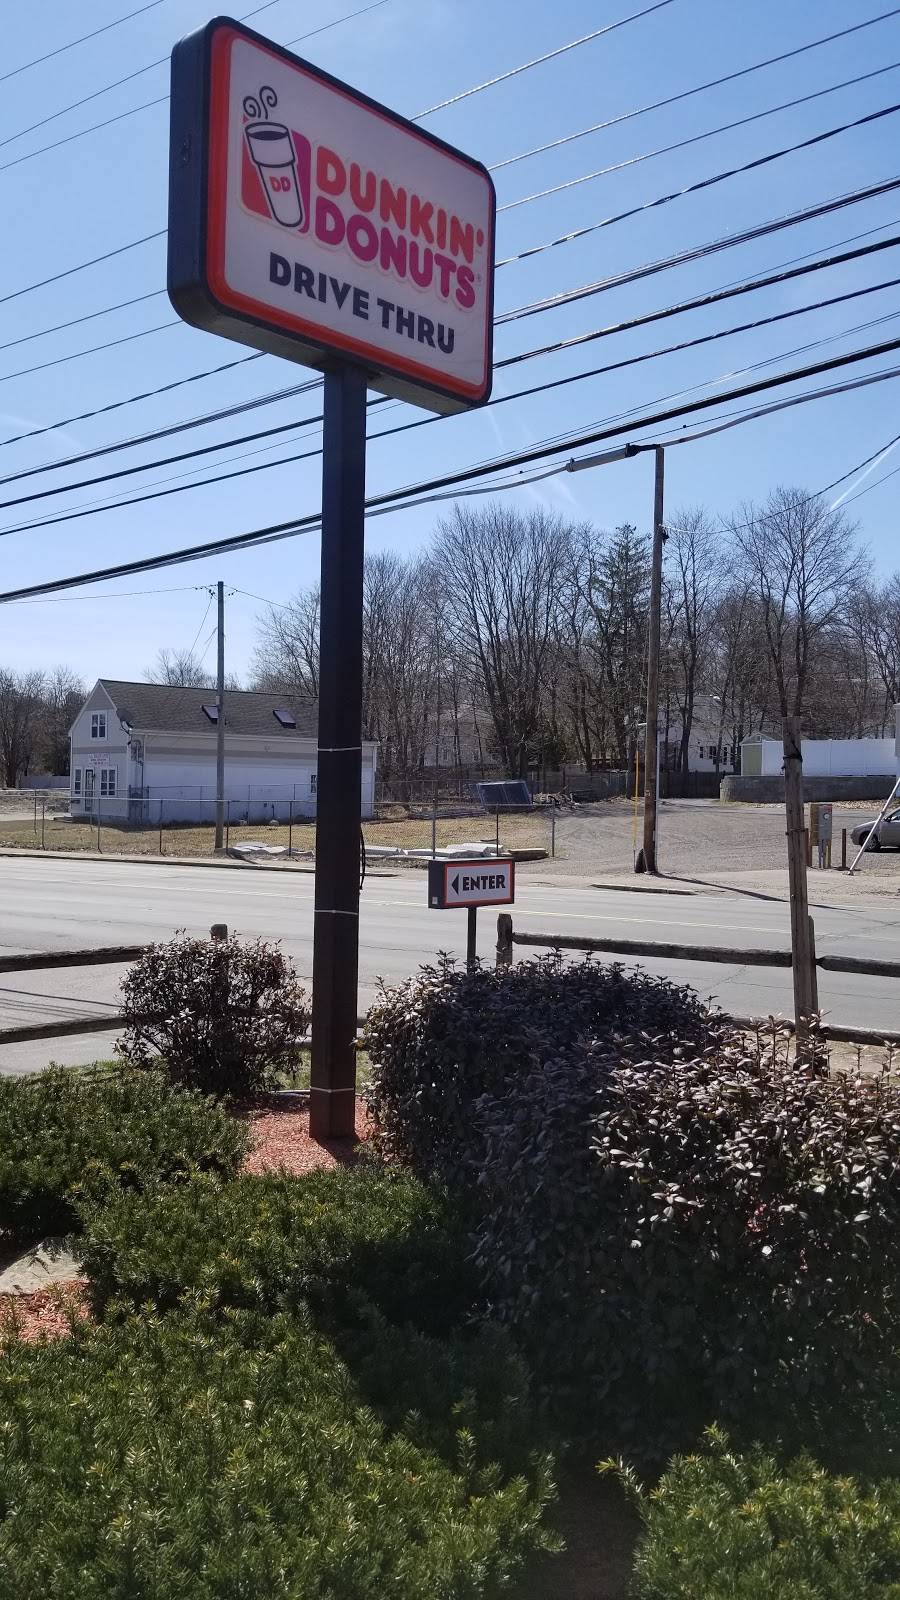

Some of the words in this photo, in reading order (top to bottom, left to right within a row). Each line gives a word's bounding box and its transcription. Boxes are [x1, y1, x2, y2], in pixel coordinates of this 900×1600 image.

[270, 176, 291, 192] DD
[316, 145, 484, 263] DUNKIN'
[270, 252, 369, 320] DRIVE
[377, 297, 455, 354] THRU
[315, 196, 475, 308] DONUTS
[463, 875, 505, 891] ENTER
